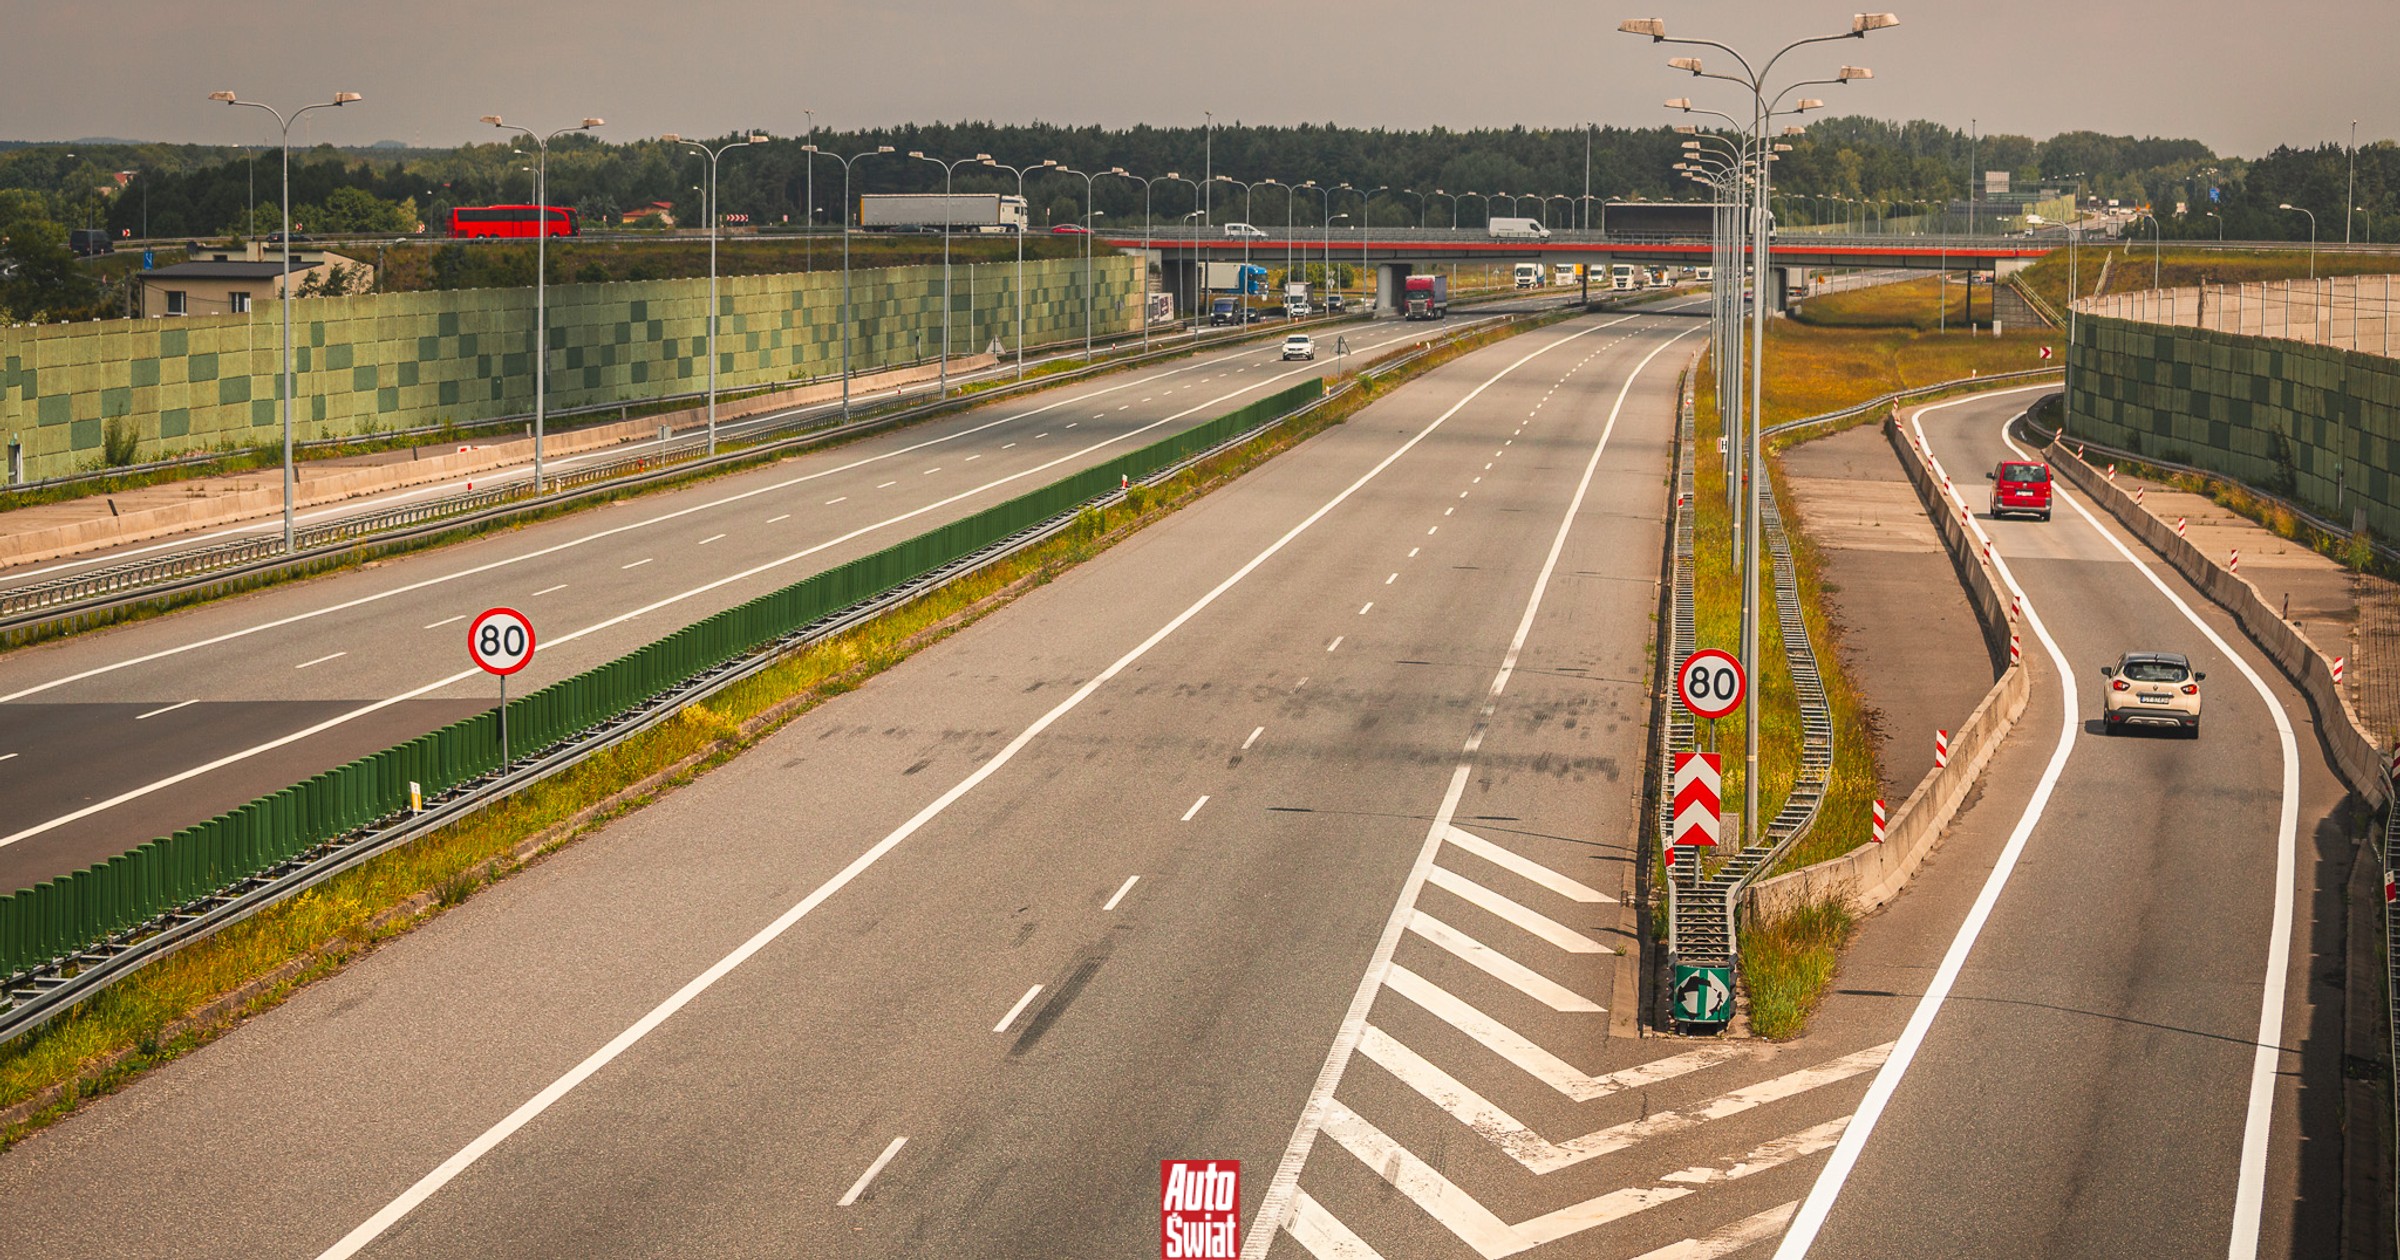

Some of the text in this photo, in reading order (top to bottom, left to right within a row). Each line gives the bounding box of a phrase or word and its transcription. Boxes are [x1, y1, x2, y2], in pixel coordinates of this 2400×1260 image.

[1721, 440, 1728, 450] H
[480, 624, 525, 657] 80
[1688, 666, 1736, 700] 80
